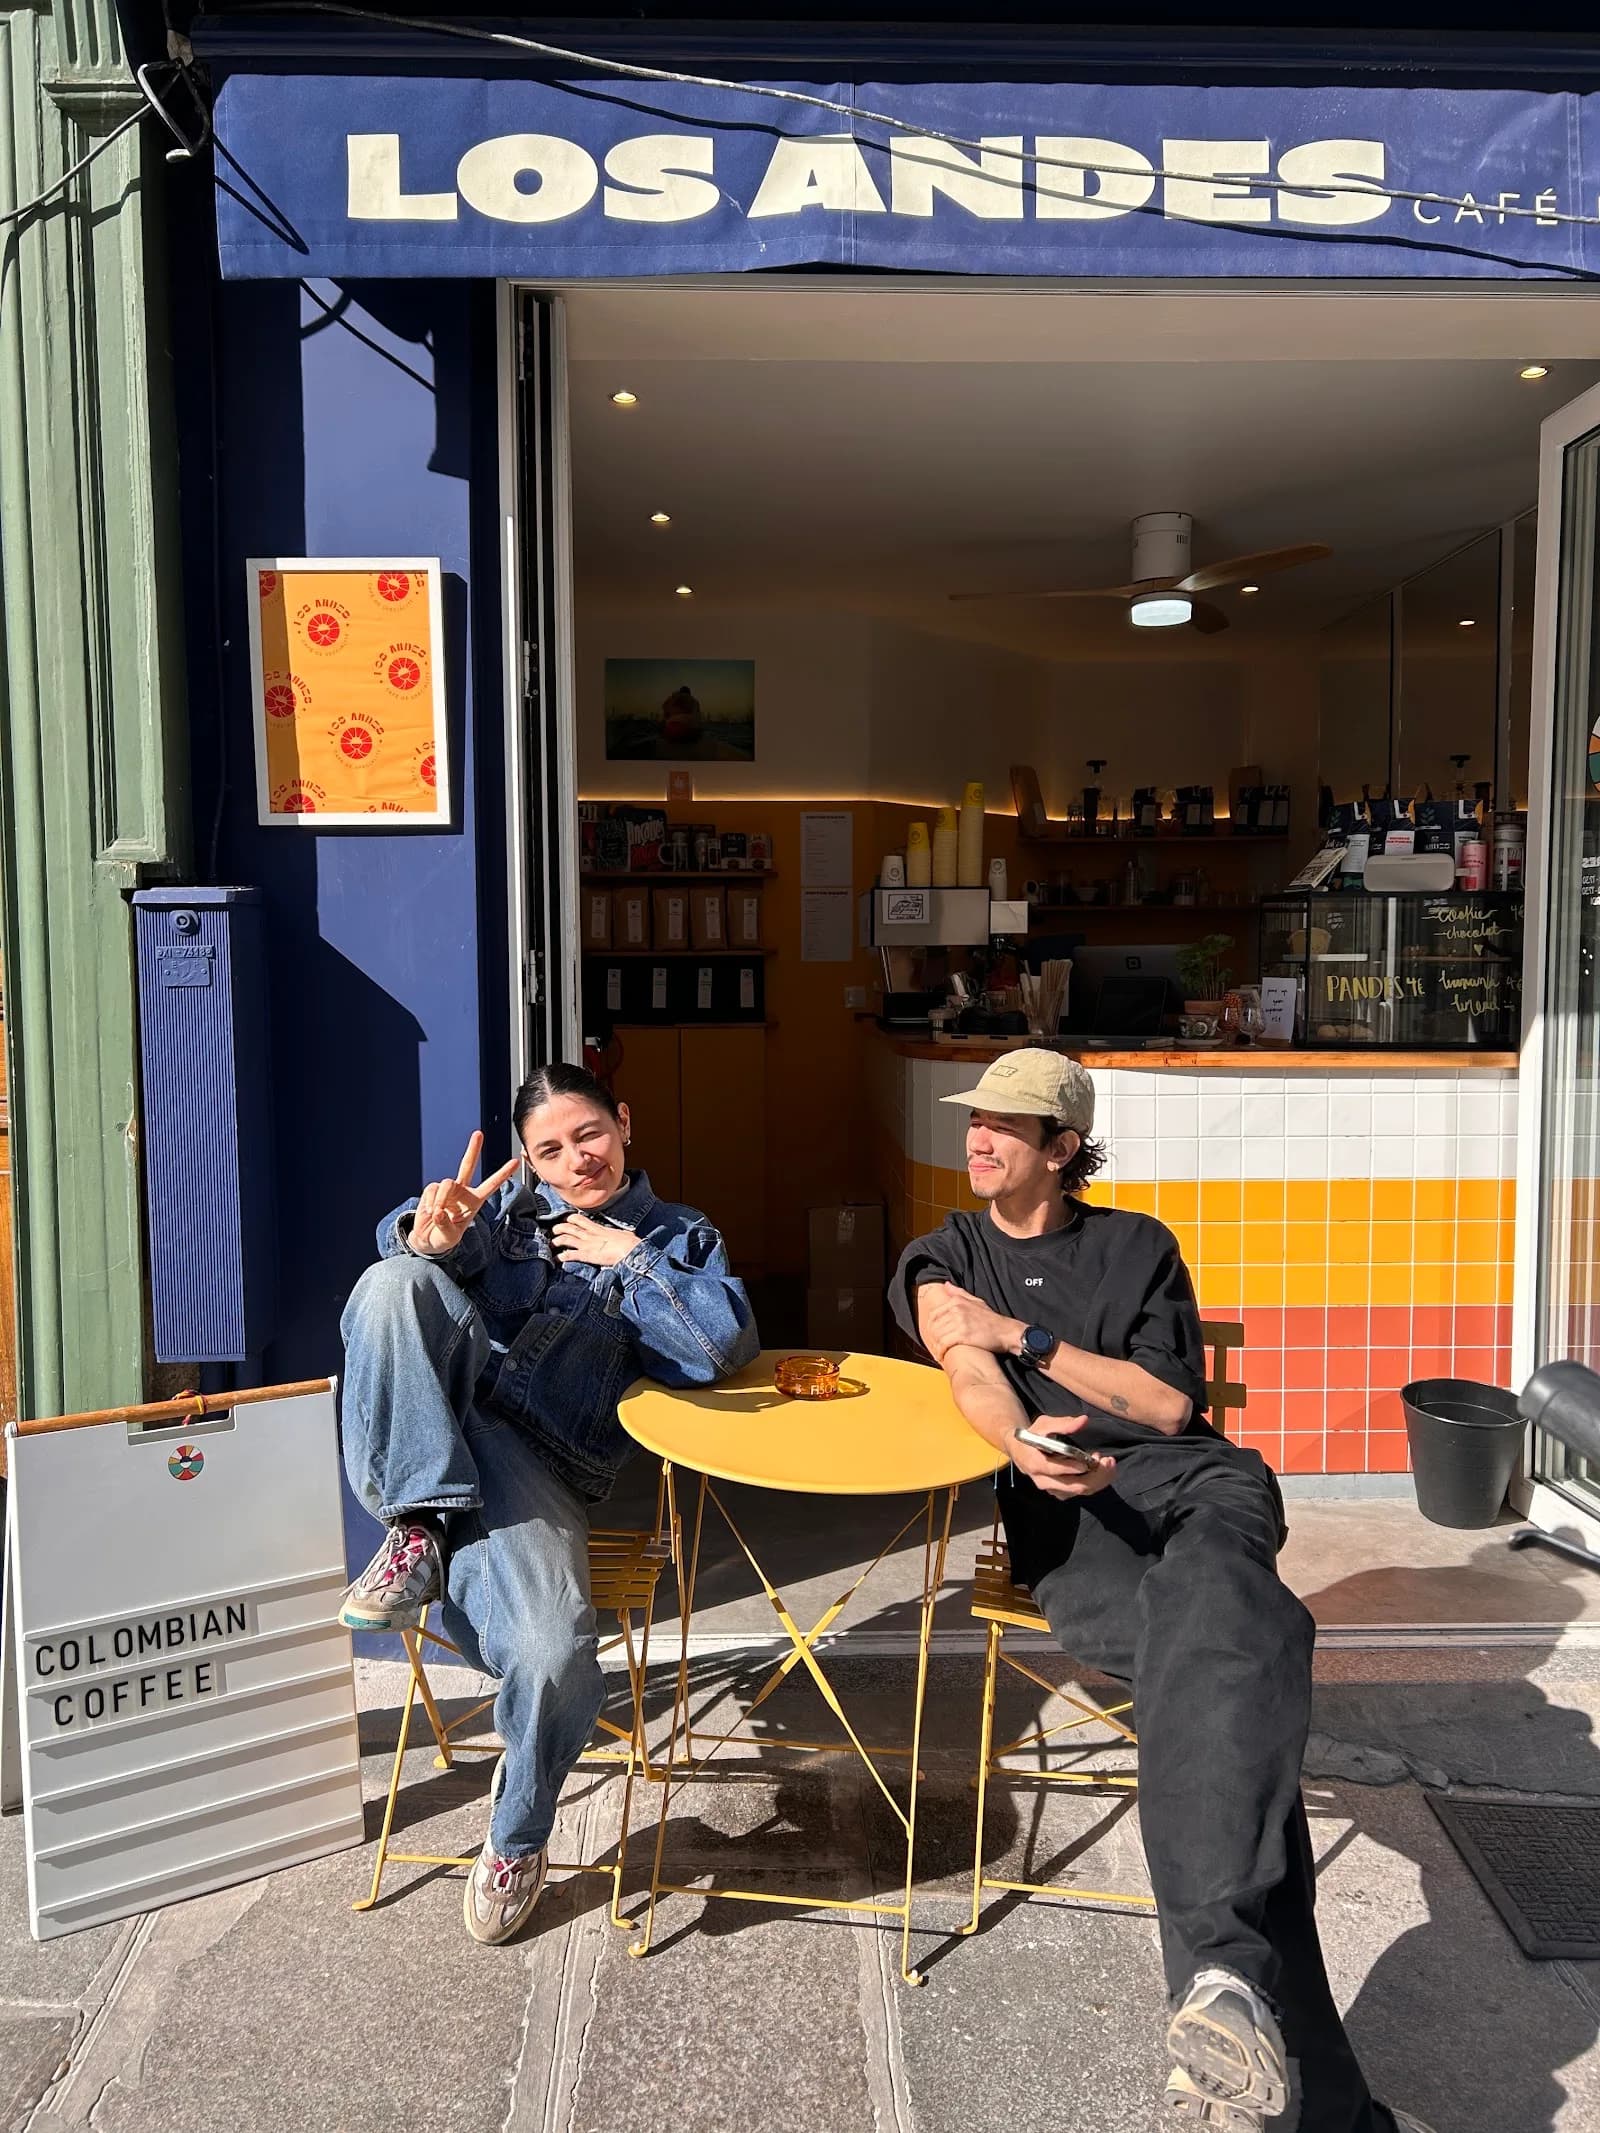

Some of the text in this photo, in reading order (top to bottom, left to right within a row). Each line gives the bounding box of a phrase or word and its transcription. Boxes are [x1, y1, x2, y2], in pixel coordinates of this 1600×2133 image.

[347, 132, 1392, 225] LOS ANDES
[1413, 186, 1560, 226] CAFÉ
[1024, 1277, 1044, 1287] OFF
[36, 1602, 247, 1677] COLOMBIAN
[54, 1663, 213, 1727] COFFEE
